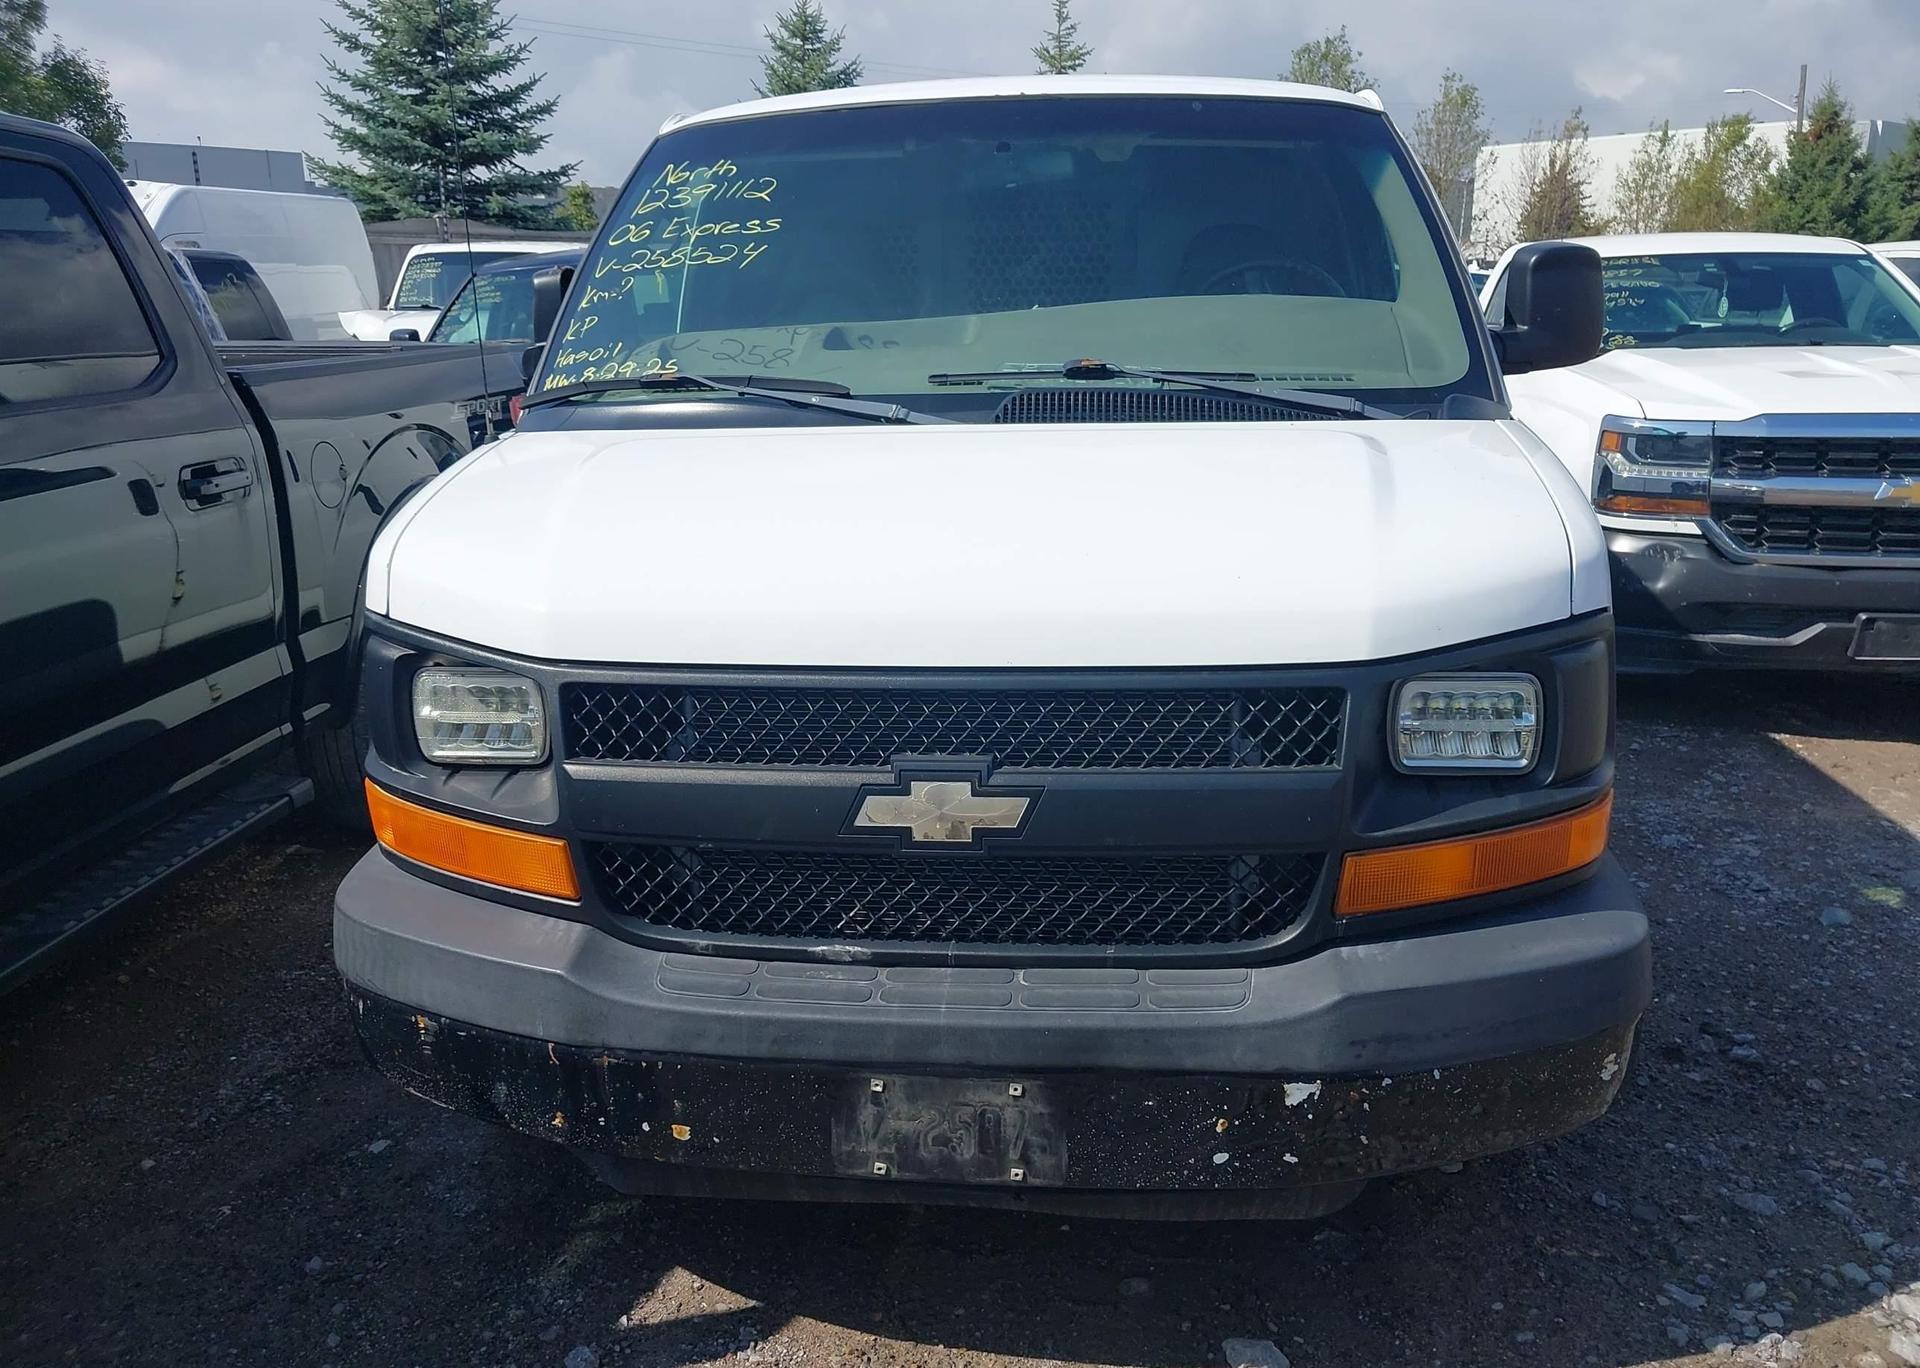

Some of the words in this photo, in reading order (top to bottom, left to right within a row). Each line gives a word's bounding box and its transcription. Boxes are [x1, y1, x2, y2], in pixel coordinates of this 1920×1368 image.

[651, 159, 737, 188] North
[630, 177, 777, 219] 12391112
[608, 220, 653, 246] 06
[662, 216, 783, 245] Express
[594, 241, 768, 279] V-258524
[562, 315, 599, 344] KP
